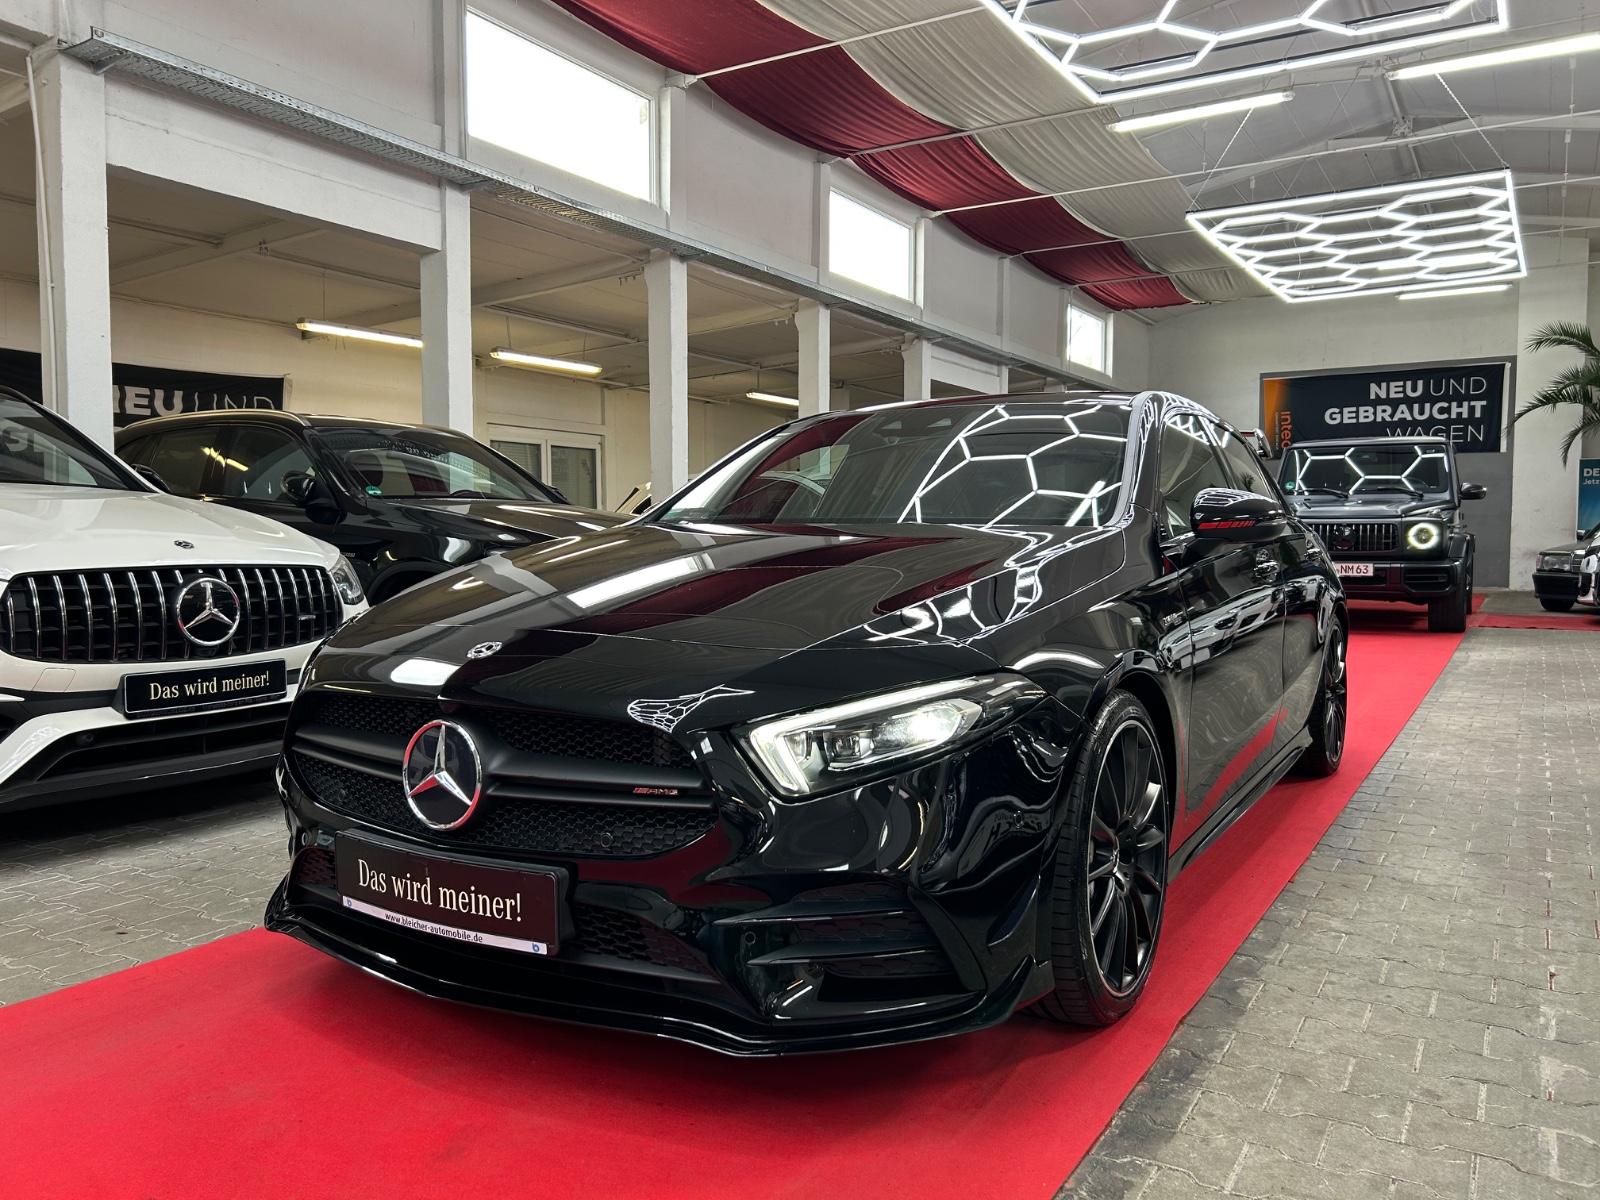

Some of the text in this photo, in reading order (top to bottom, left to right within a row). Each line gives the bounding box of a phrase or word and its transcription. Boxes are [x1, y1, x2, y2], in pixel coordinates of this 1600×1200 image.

[1369, 376, 1487, 400] NEU UND
[1324, 400, 1487, 425] GEBRAUCHT
[1340, 564, 1369, 574] NM 63
[150, 670, 270, 701] Das wird meiner!
[358, 858, 522, 922] Das wird meiner!
[385, 912, 483, 943] www.bleicher-automobile.de
